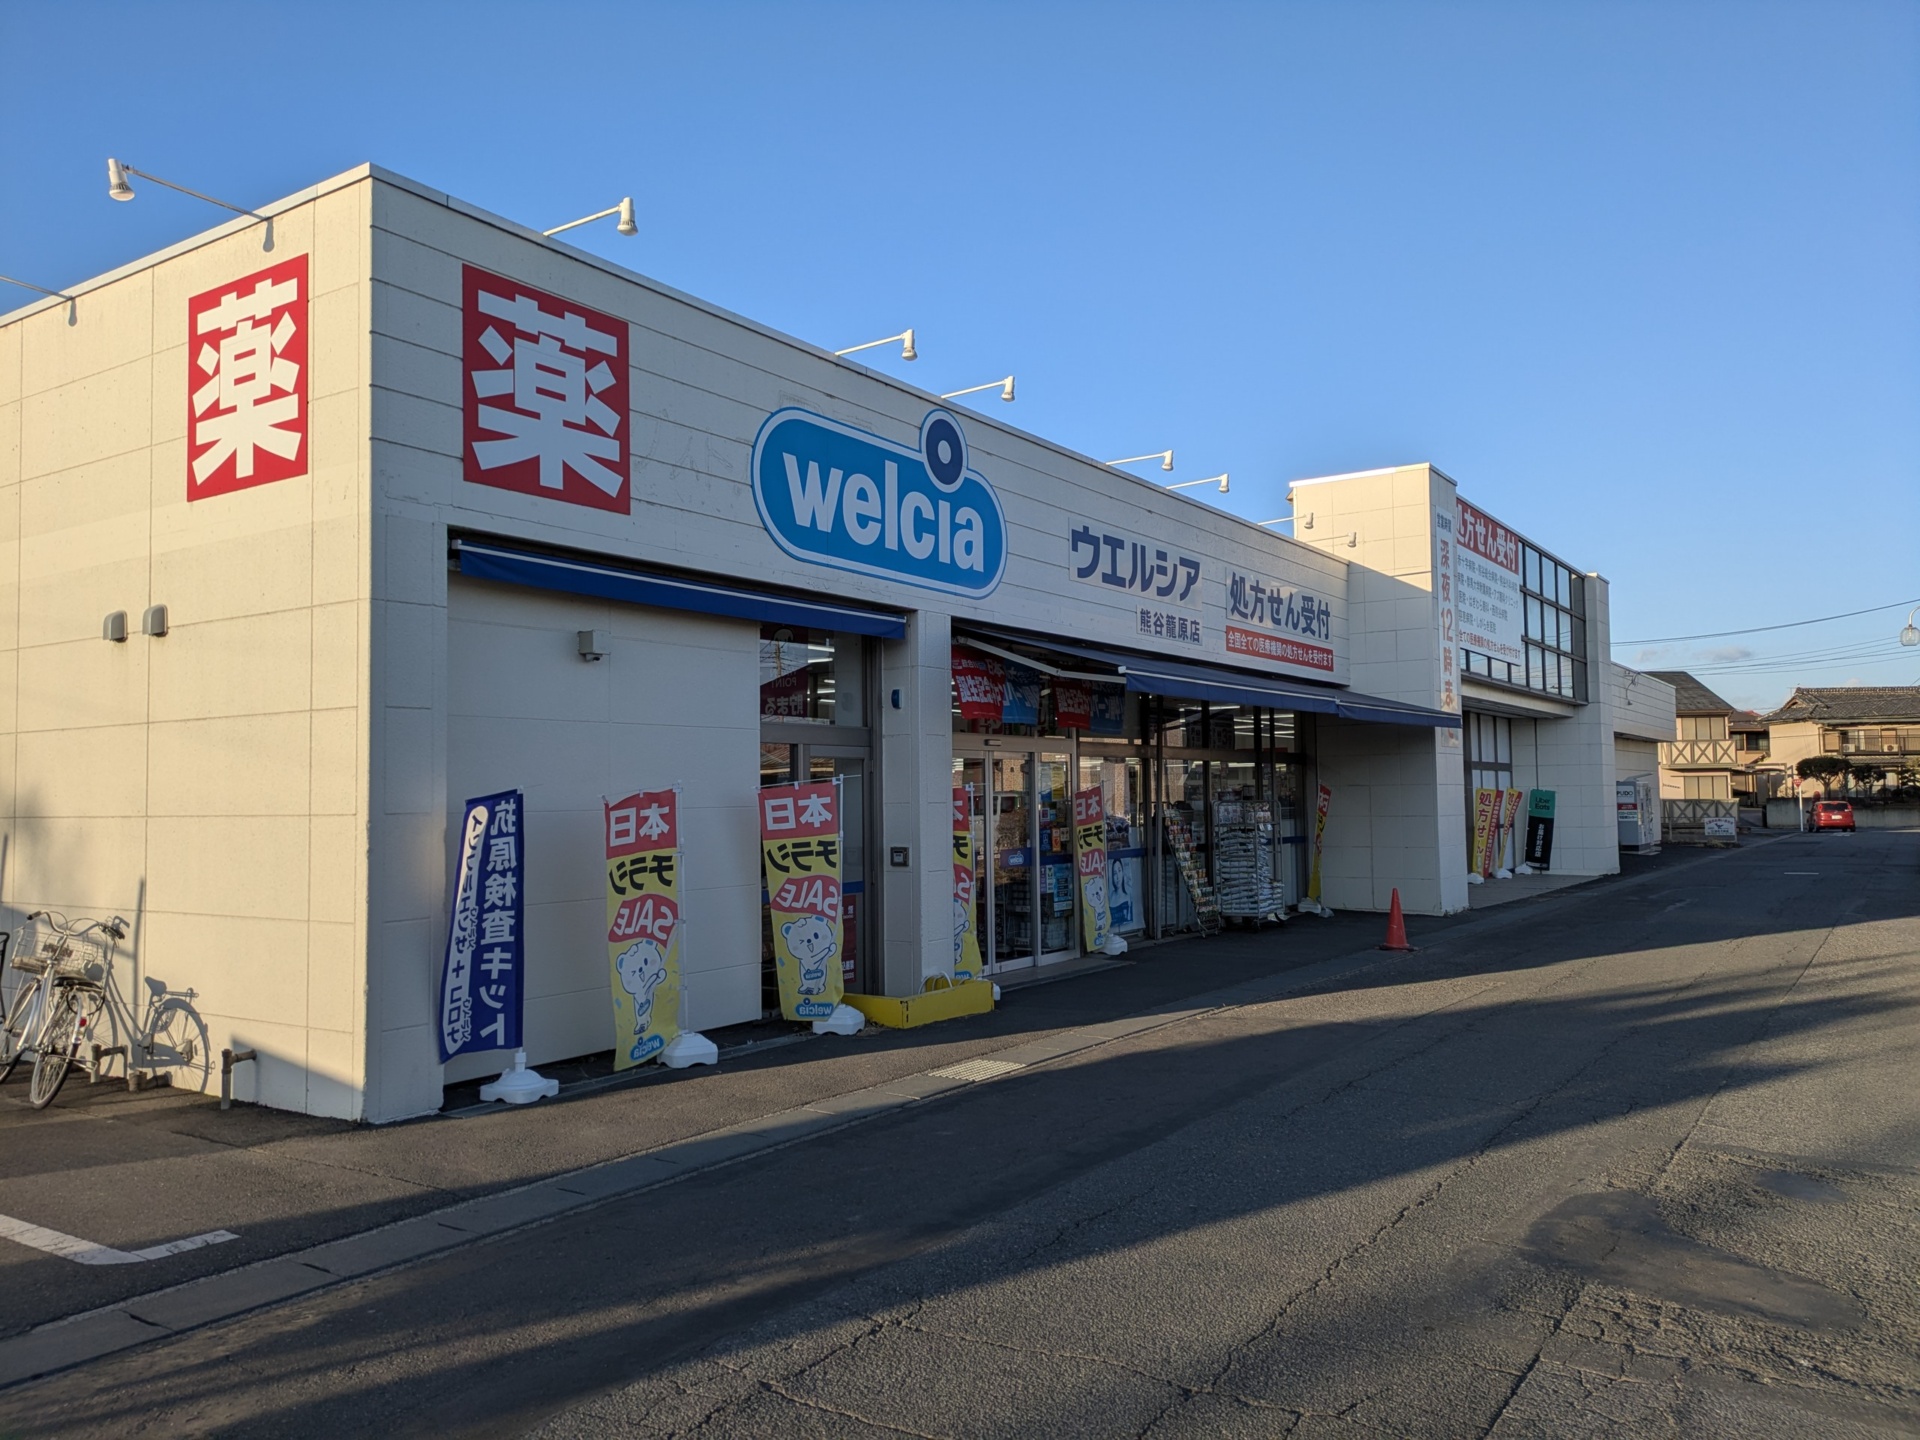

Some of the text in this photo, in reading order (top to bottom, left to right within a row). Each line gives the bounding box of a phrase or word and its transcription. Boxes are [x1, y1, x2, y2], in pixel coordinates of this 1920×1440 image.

[191, 278, 302, 485] 薬
[471, 290, 623, 497] 薬
[782, 418, 984, 571] welcia
[1071, 525, 1200, 601] ウエルシア
[1140, 608, 1200, 643] 熊谷籠原店
[1230, 572, 1330, 640] 処方せん受付
[1228, 631, 1332, 667] 全国全ての医療機関の処方せんを受付ます
[1477, 792, 1492, 854] 処方せん
